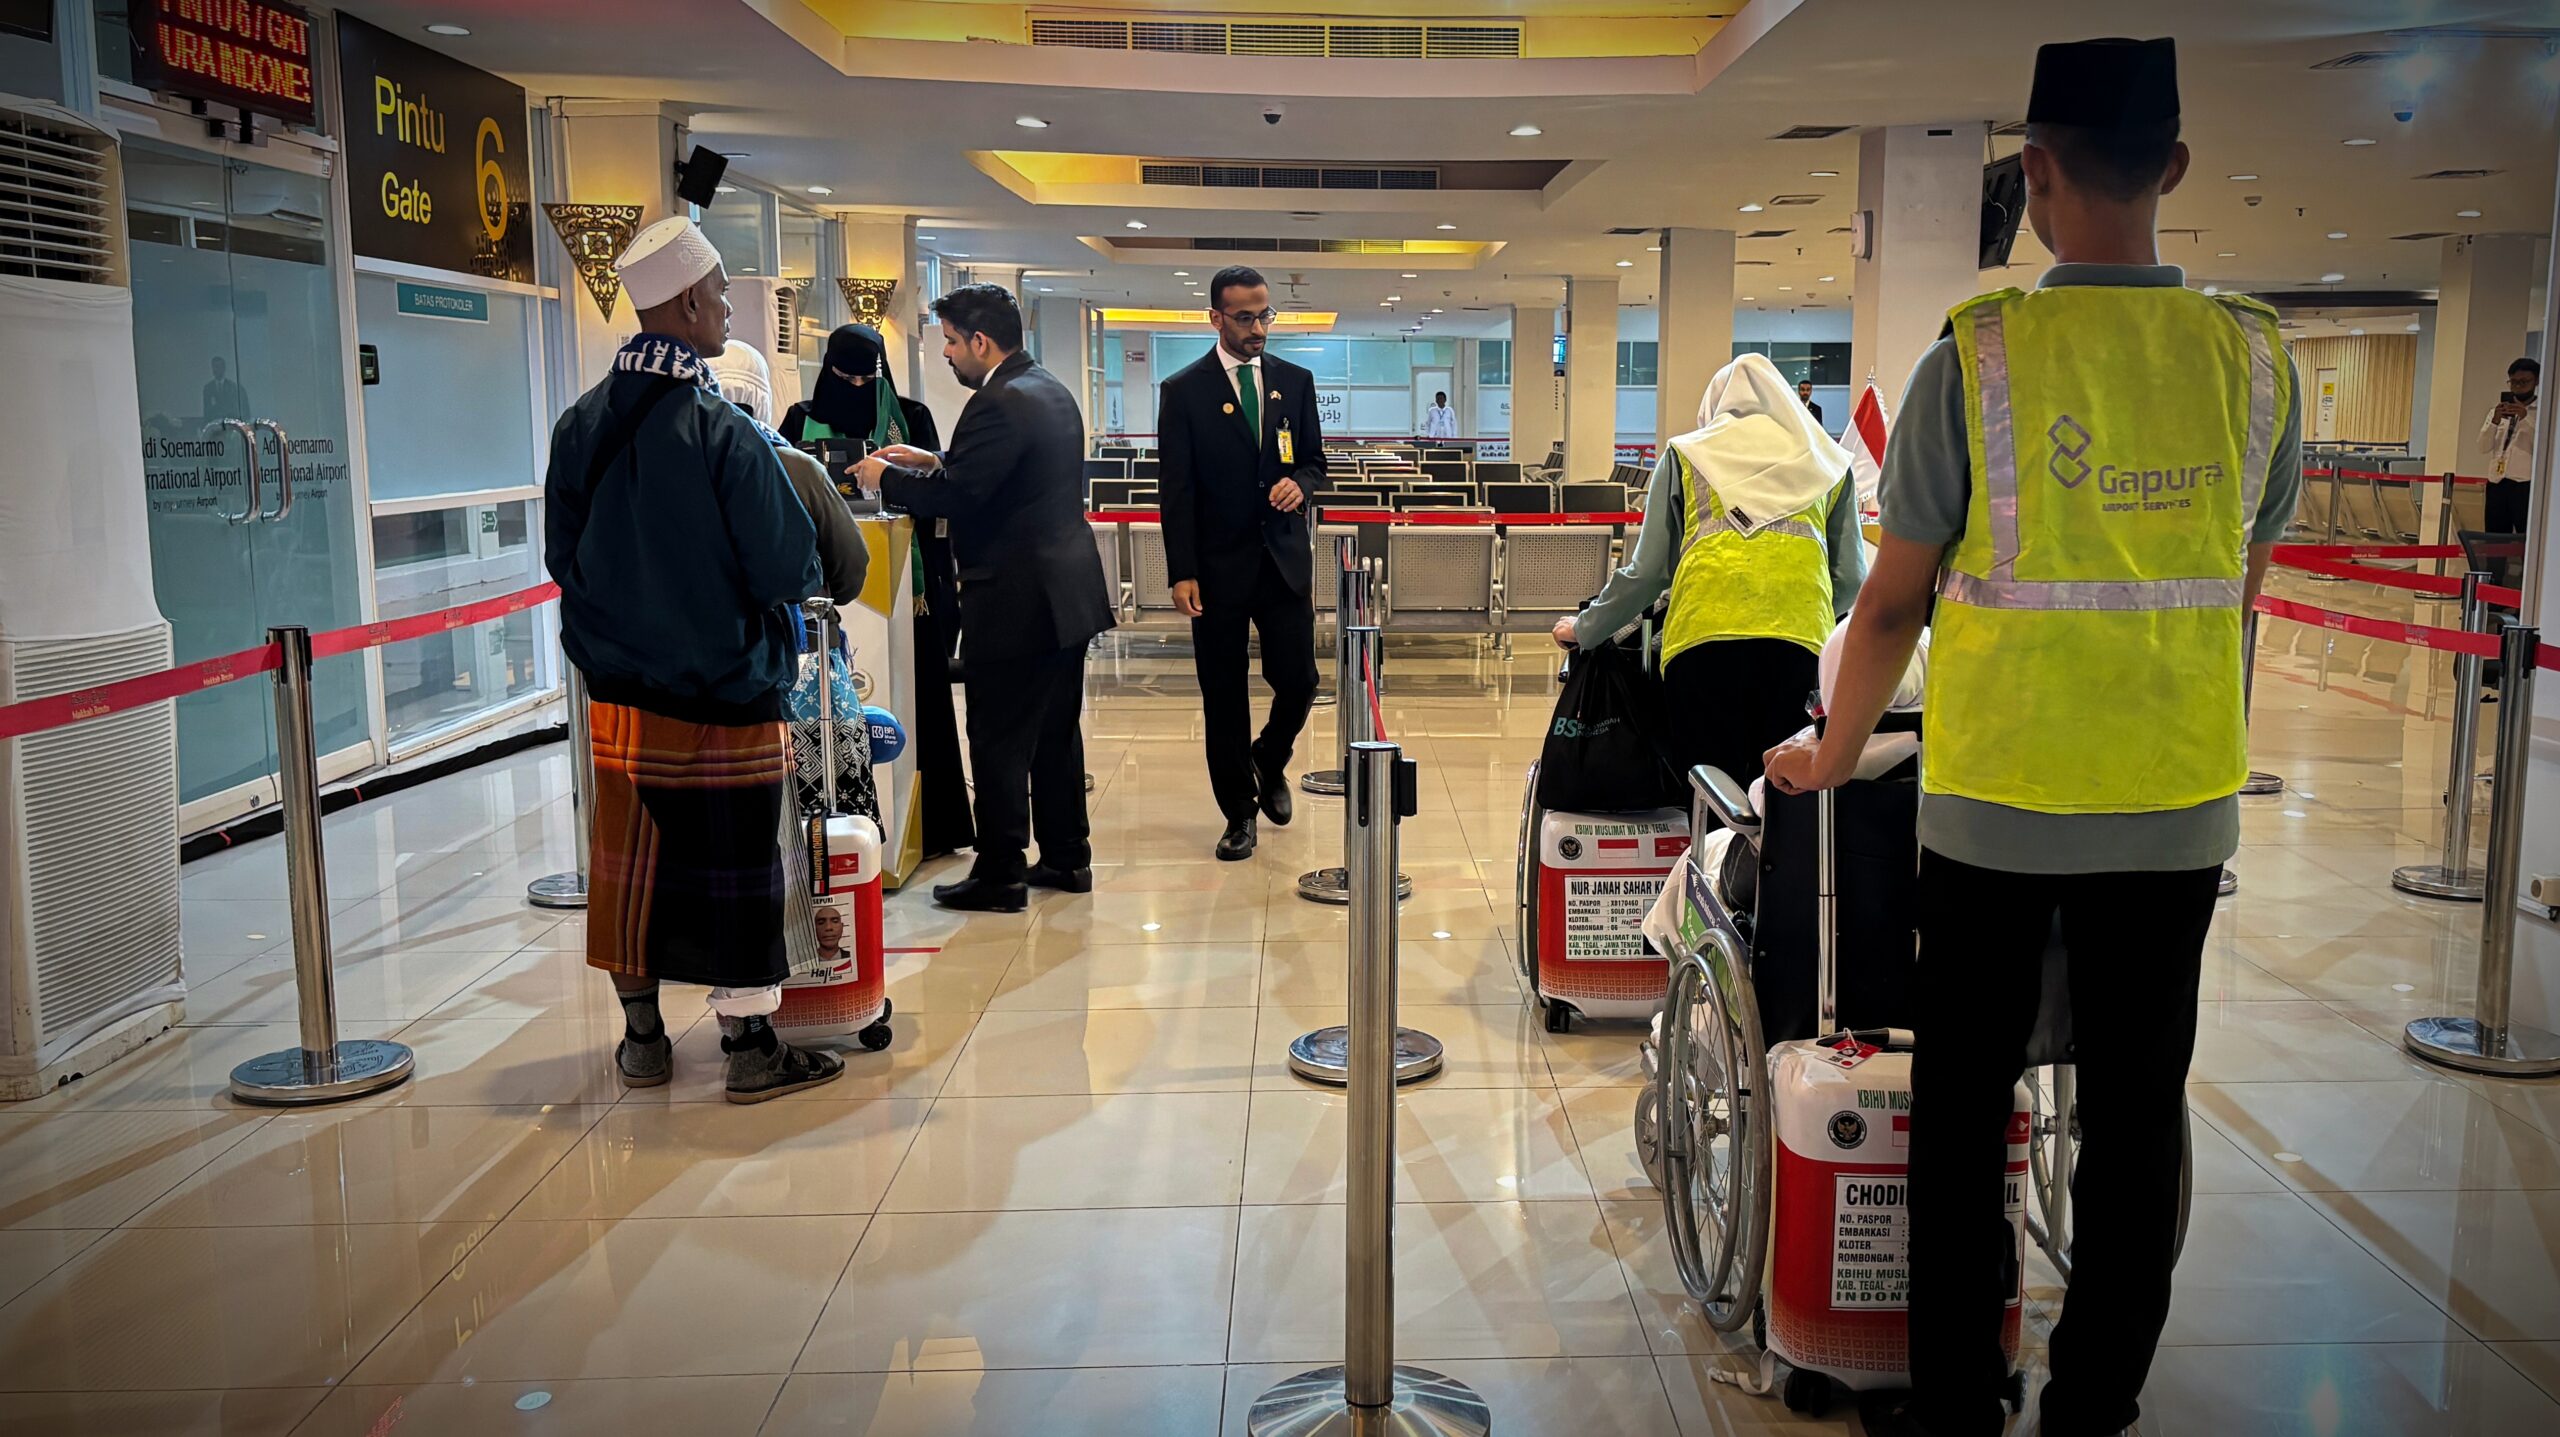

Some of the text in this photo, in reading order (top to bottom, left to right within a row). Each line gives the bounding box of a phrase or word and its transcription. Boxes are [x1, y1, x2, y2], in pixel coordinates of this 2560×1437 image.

[375, 75, 445, 154] Pintu
[476, 117, 508, 241] 6
[381, 171, 432, 225] Gate
[414, 293, 474, 311] BATAS PROTOKOLER
[142, 437, 225, 459] di Soemarmo
[287, 438, 334, 455] oemarmo
[204, 467, 242, 490] Airport
[317, 462, 348, 484] Airport
[2099, 462, 2225, 502] Gapura
[1595, 824, 1625, 836] MUSLIMAT
[1627, 825, 1636, 835] NU
[1652, 823, 1670, 833] TEGAL
[1571, 881, 1589, 895] NUR
[1592, 881, 1621, 895] JANAH
[1623, 881, 1652, 895] SAHAR
[811, 967, 832, 983] Haji
[1857, 1089, 1885, 1109] KBIHU
[1840, 1214, 1855, 1224] NO.
[1857, 1214, 1892, 1224] PASPOR
[1839, 1227, 1890, 1237] EMBARKASI
[1839, 1240, 1871, 1250] KLOTER
[1838, 1253, 1894, 1263] ROMBONGAN
[1837, 1269, 1872, 1279] KBIHU
[1836, 1280, 1856, 1291] KAB.
[1859, 1281, 1885, 1291] TEGAL
